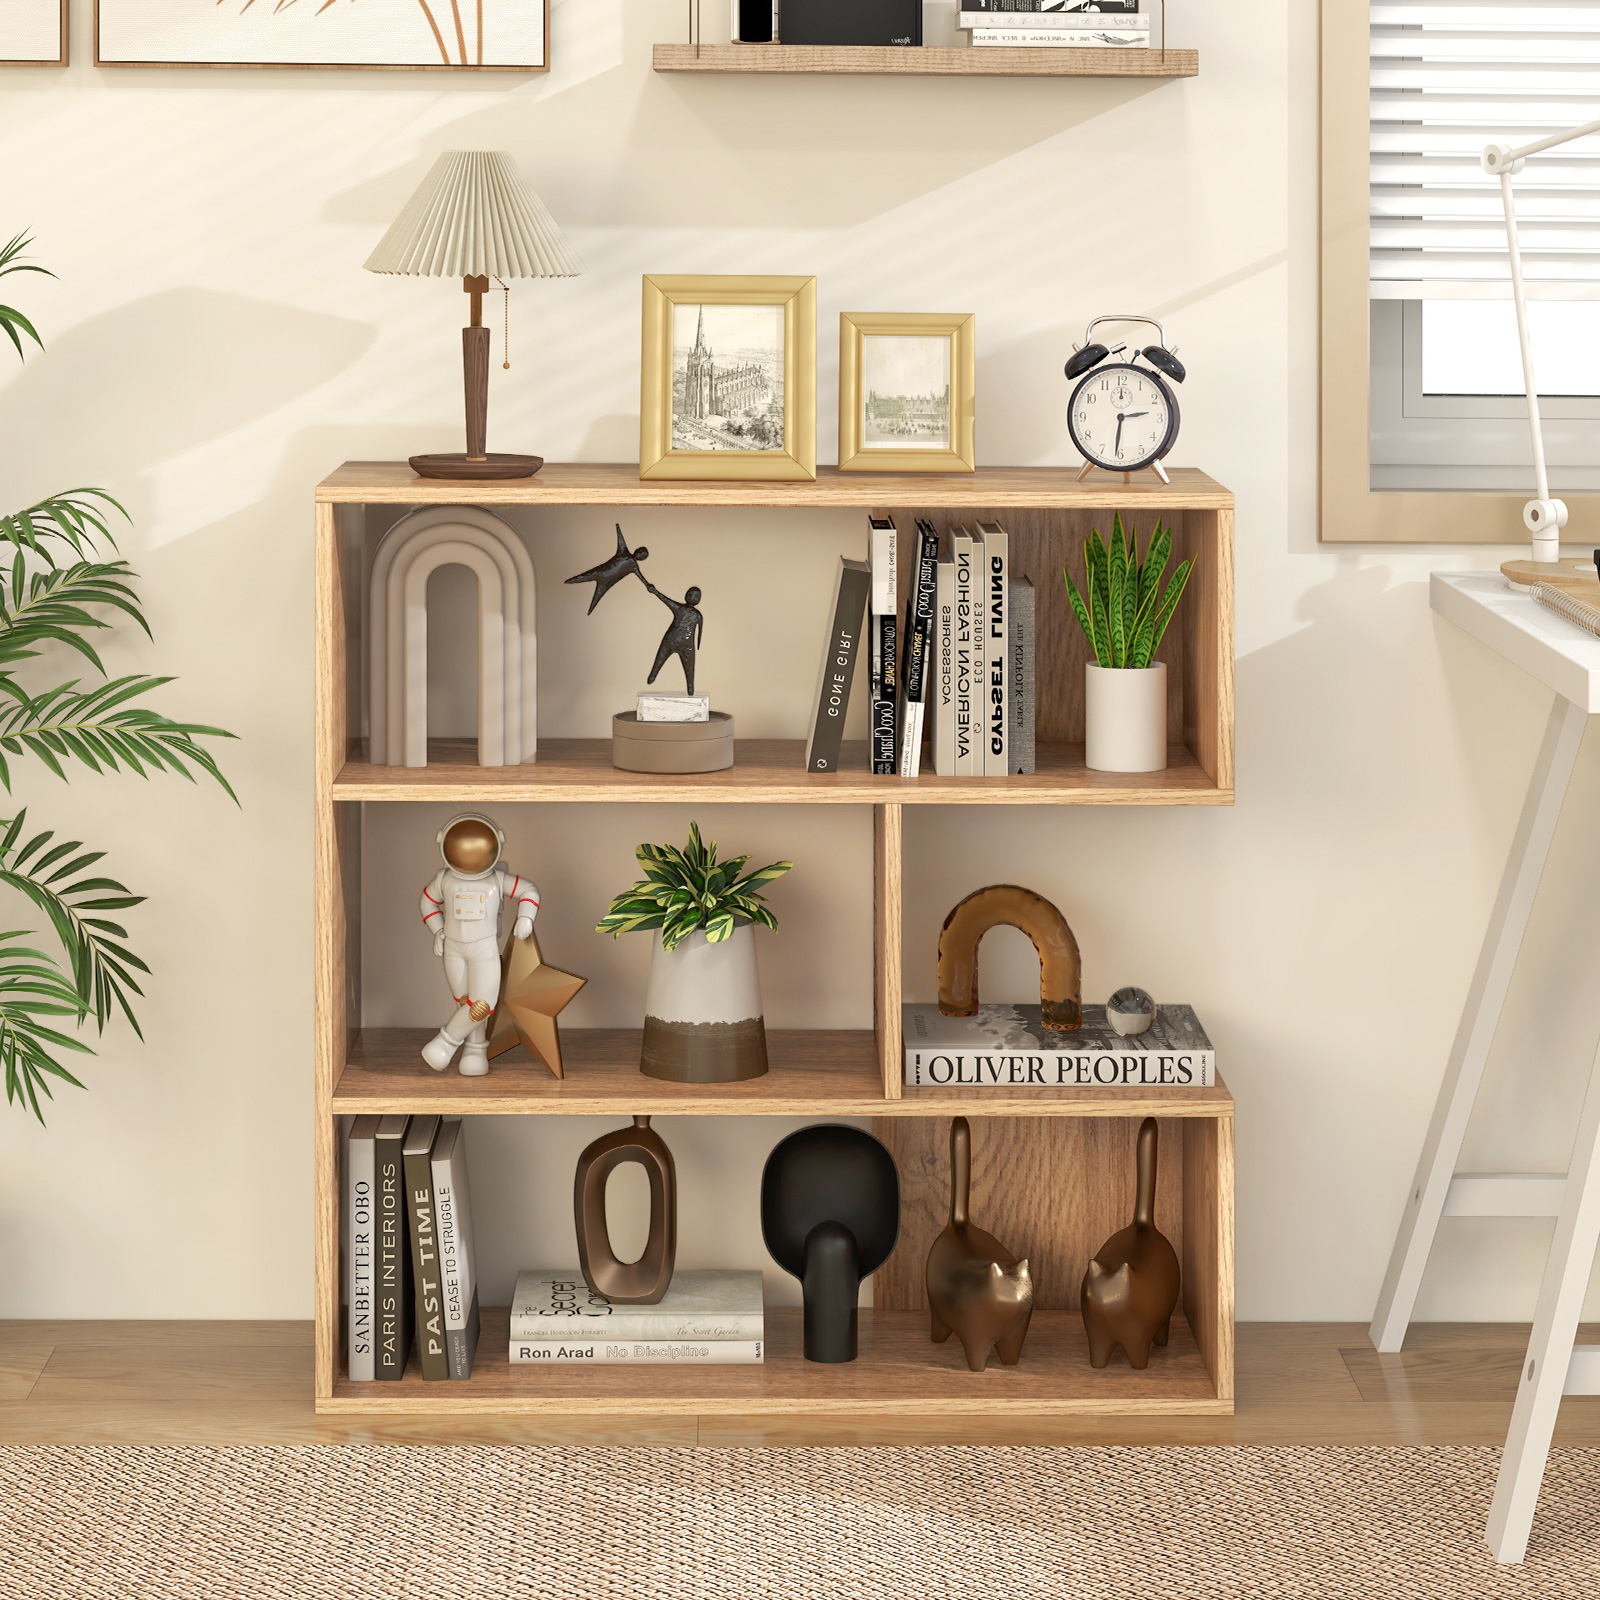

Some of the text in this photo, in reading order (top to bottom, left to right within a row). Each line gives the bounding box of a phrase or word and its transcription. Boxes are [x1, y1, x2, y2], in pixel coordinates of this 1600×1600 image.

[1101, 380, 1109, 391] 11
[1117, 376, 1128, 386] 12
[1138, 380, 1142, 391] 1
[1086, 393, 1097, 404] 10
[1151, 394, 1158, 405] 2
[1079, 411, 1087, 422] 9
[1156, 413, 1164, 424] 3
[1084, 430, 1092, 441] 8
[1149, 431, 1157, 442] 4
[1099, 443, 1106, 455] 7
[1116, 448, 1124, 460] 6
[1138, 444, 1145, 455] 5
[928, 1055, 1047, 1084] OLIVER
[1055, 1055, 1193, 1084] PEOPLES
[438, 1187, 461, 1321] CEASE TO STRUGGLE
[354, 1181, 370, 1354] SANBETTER OBO
[382, 1163, 396, 1366] PARIS INTERIORS
[414, 1188, 443, 1355] PAST TIME
[539, 1280, 577, 1317] Secret
[693, 1326, 712, 1335] Secret
[713, 1322, 740, 1337] Garden
[520, 1344, 709, 1359] Ron Arad No Discipline
